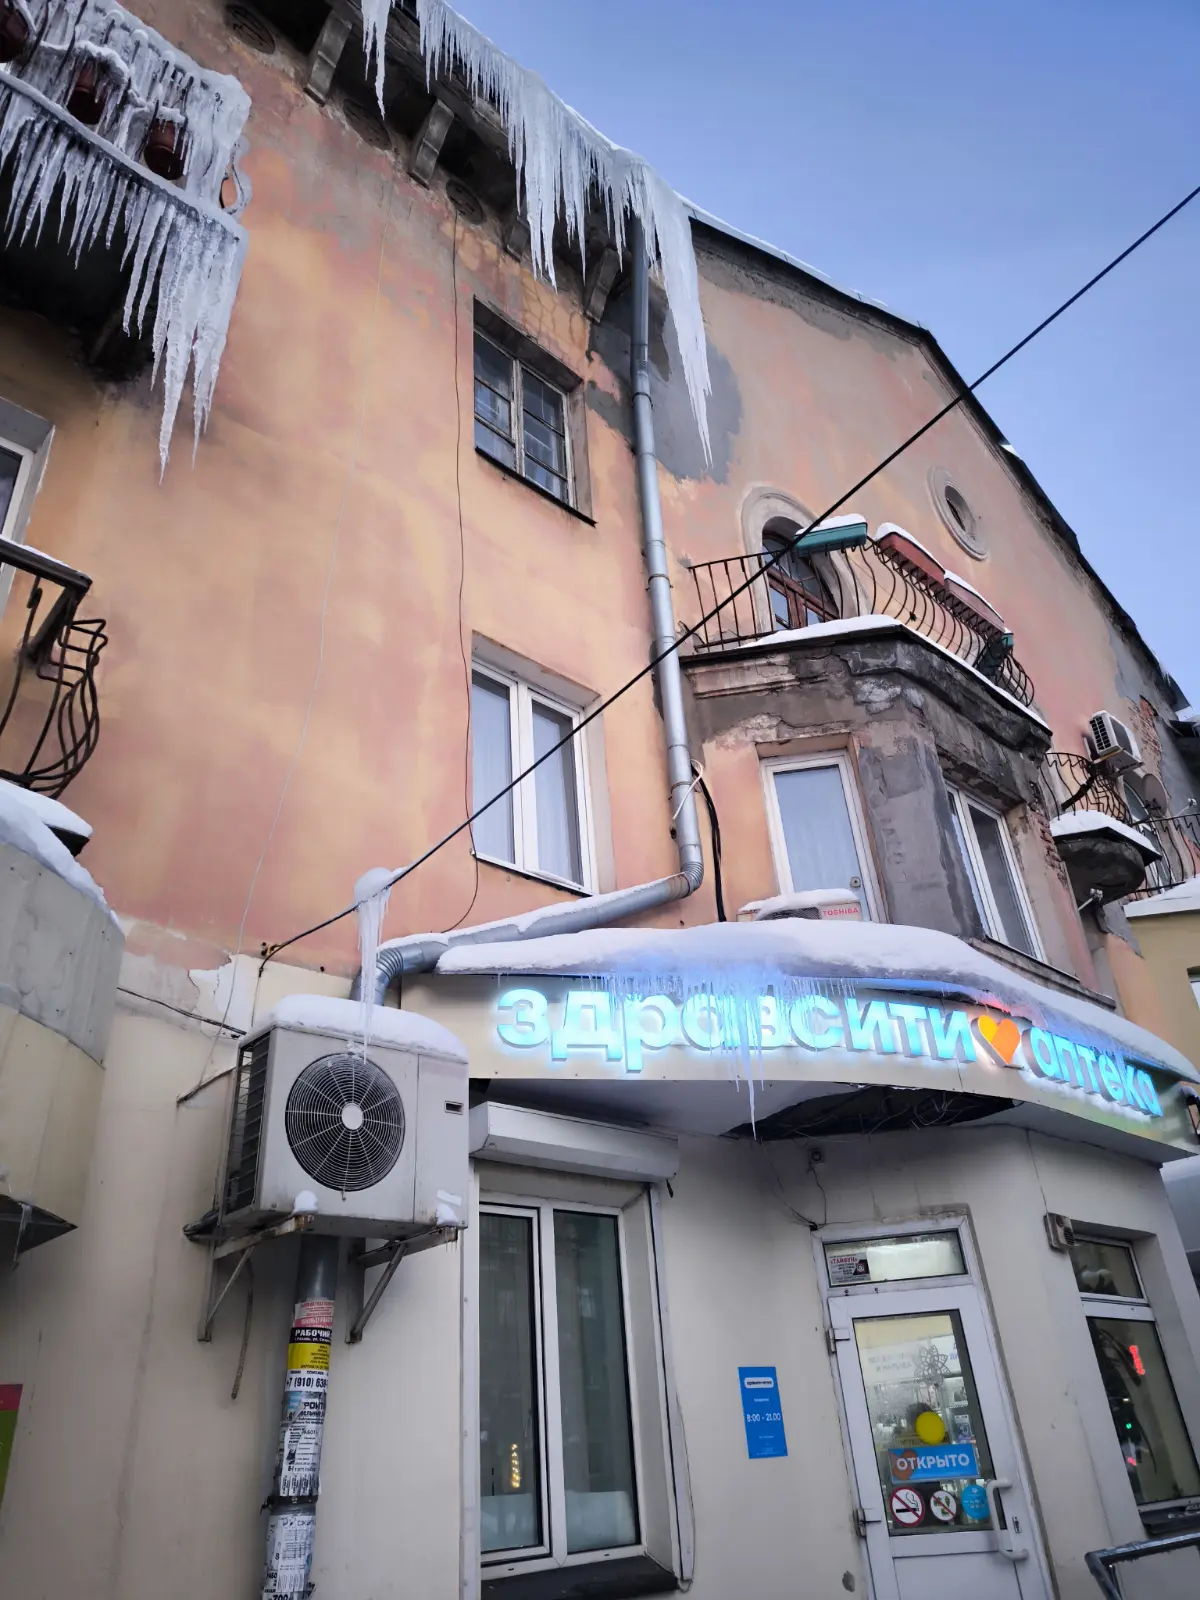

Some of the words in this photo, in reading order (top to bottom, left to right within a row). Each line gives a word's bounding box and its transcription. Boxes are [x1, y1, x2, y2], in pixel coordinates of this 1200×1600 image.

[822, 907, 859, 917] TOSHIBA
[1021, 1027, 1164, 1117] аптека
[294, 1377, 314, 1388] (910)
[896, 1453, 970, 1471] ОТКРЫТО
